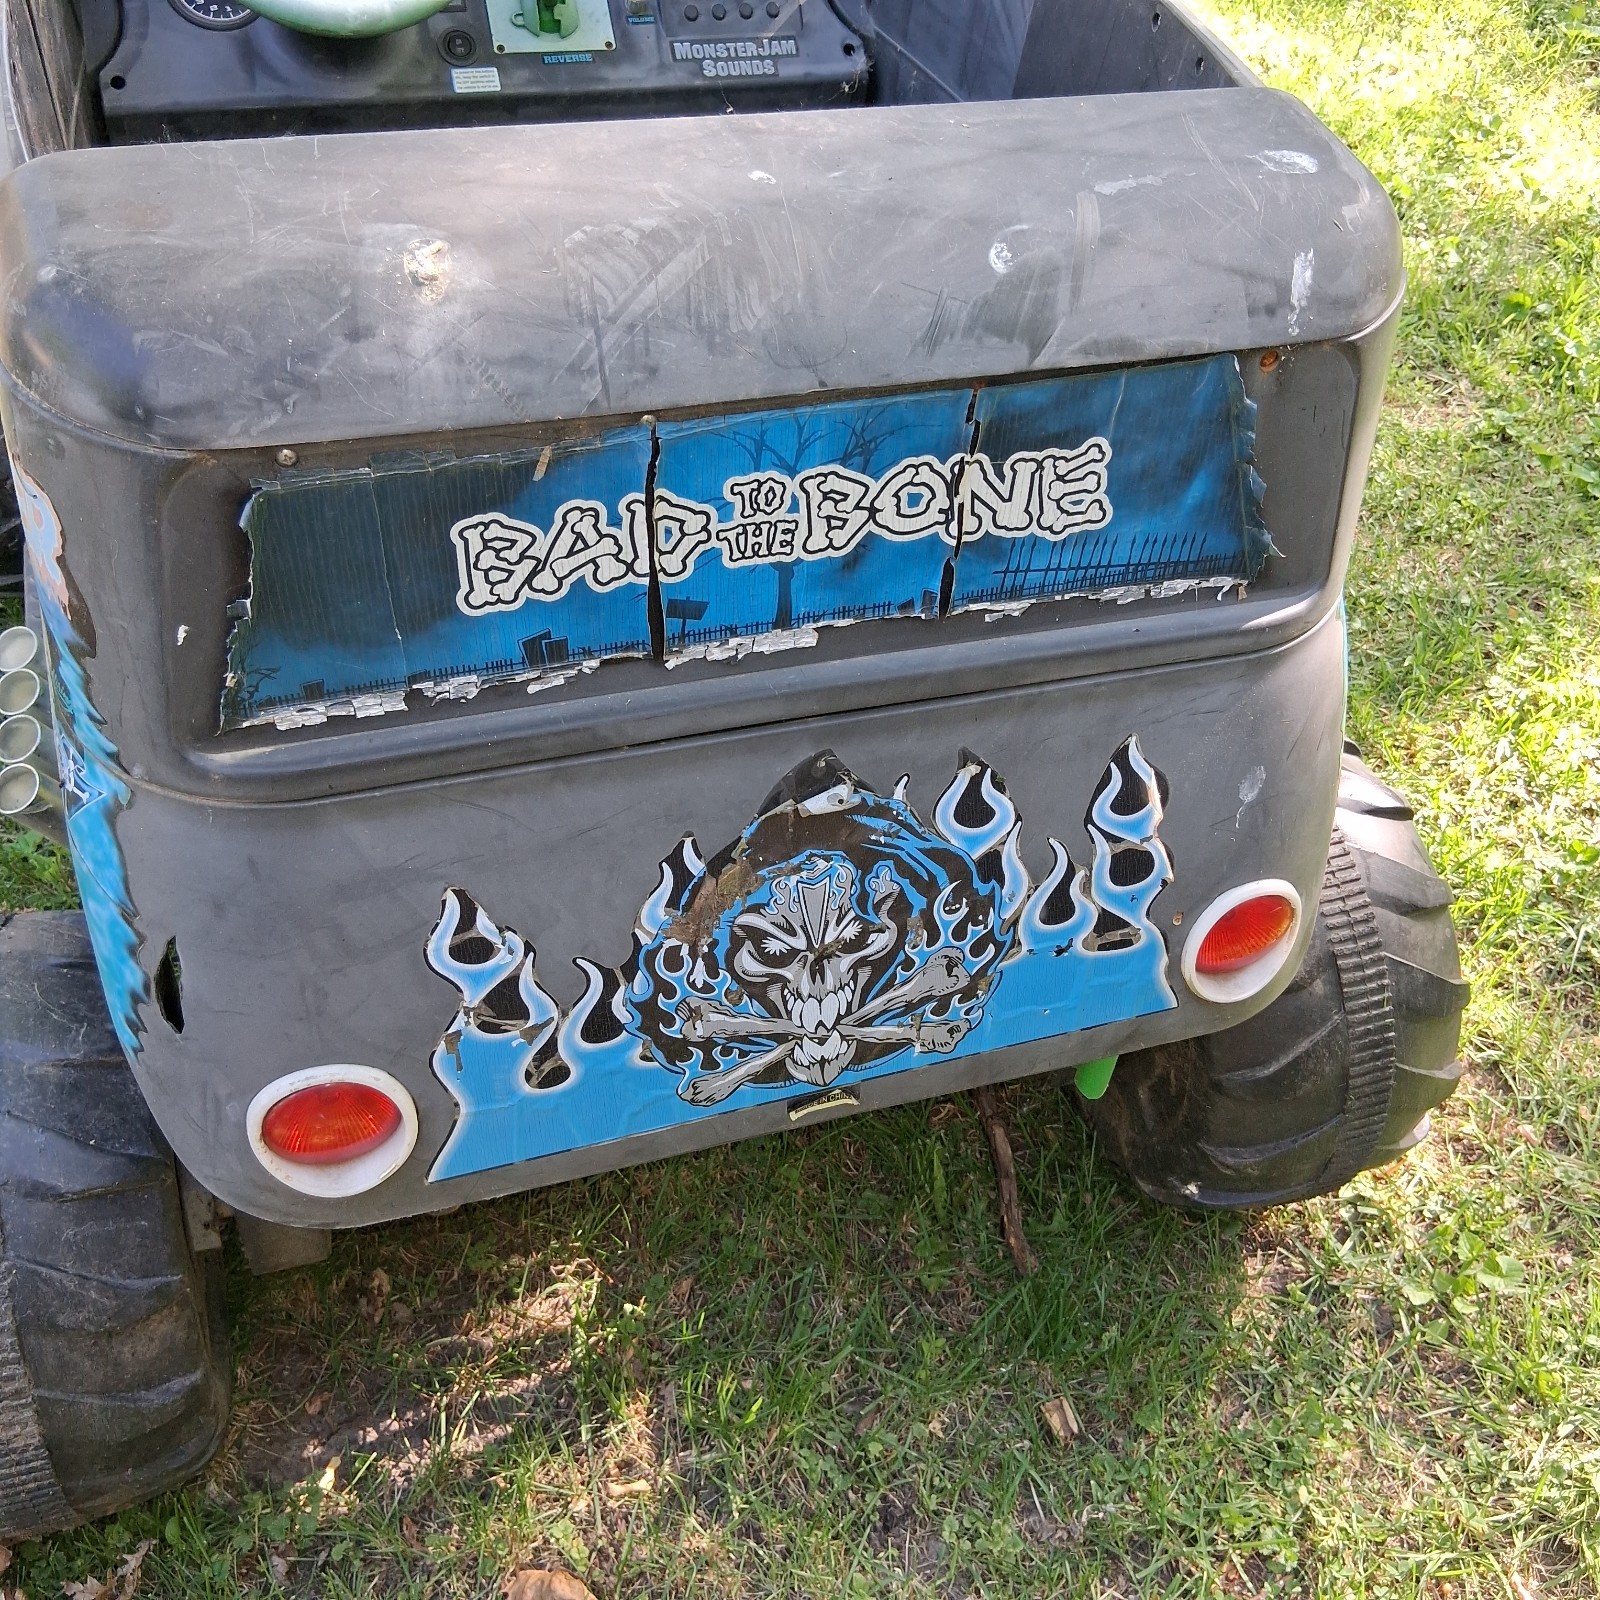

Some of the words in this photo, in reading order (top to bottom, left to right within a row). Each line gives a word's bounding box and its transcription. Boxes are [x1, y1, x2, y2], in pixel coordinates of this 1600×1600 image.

[543, 53, 593, 64] REVERSE
[702, 59, 775, 77] SOUNDS
[729, 476, 788, 519] TO
[799, 442, 1108, 556] BONE
[456, 493, 713, 611] BAD
[716, 519, 799, 563] THE
